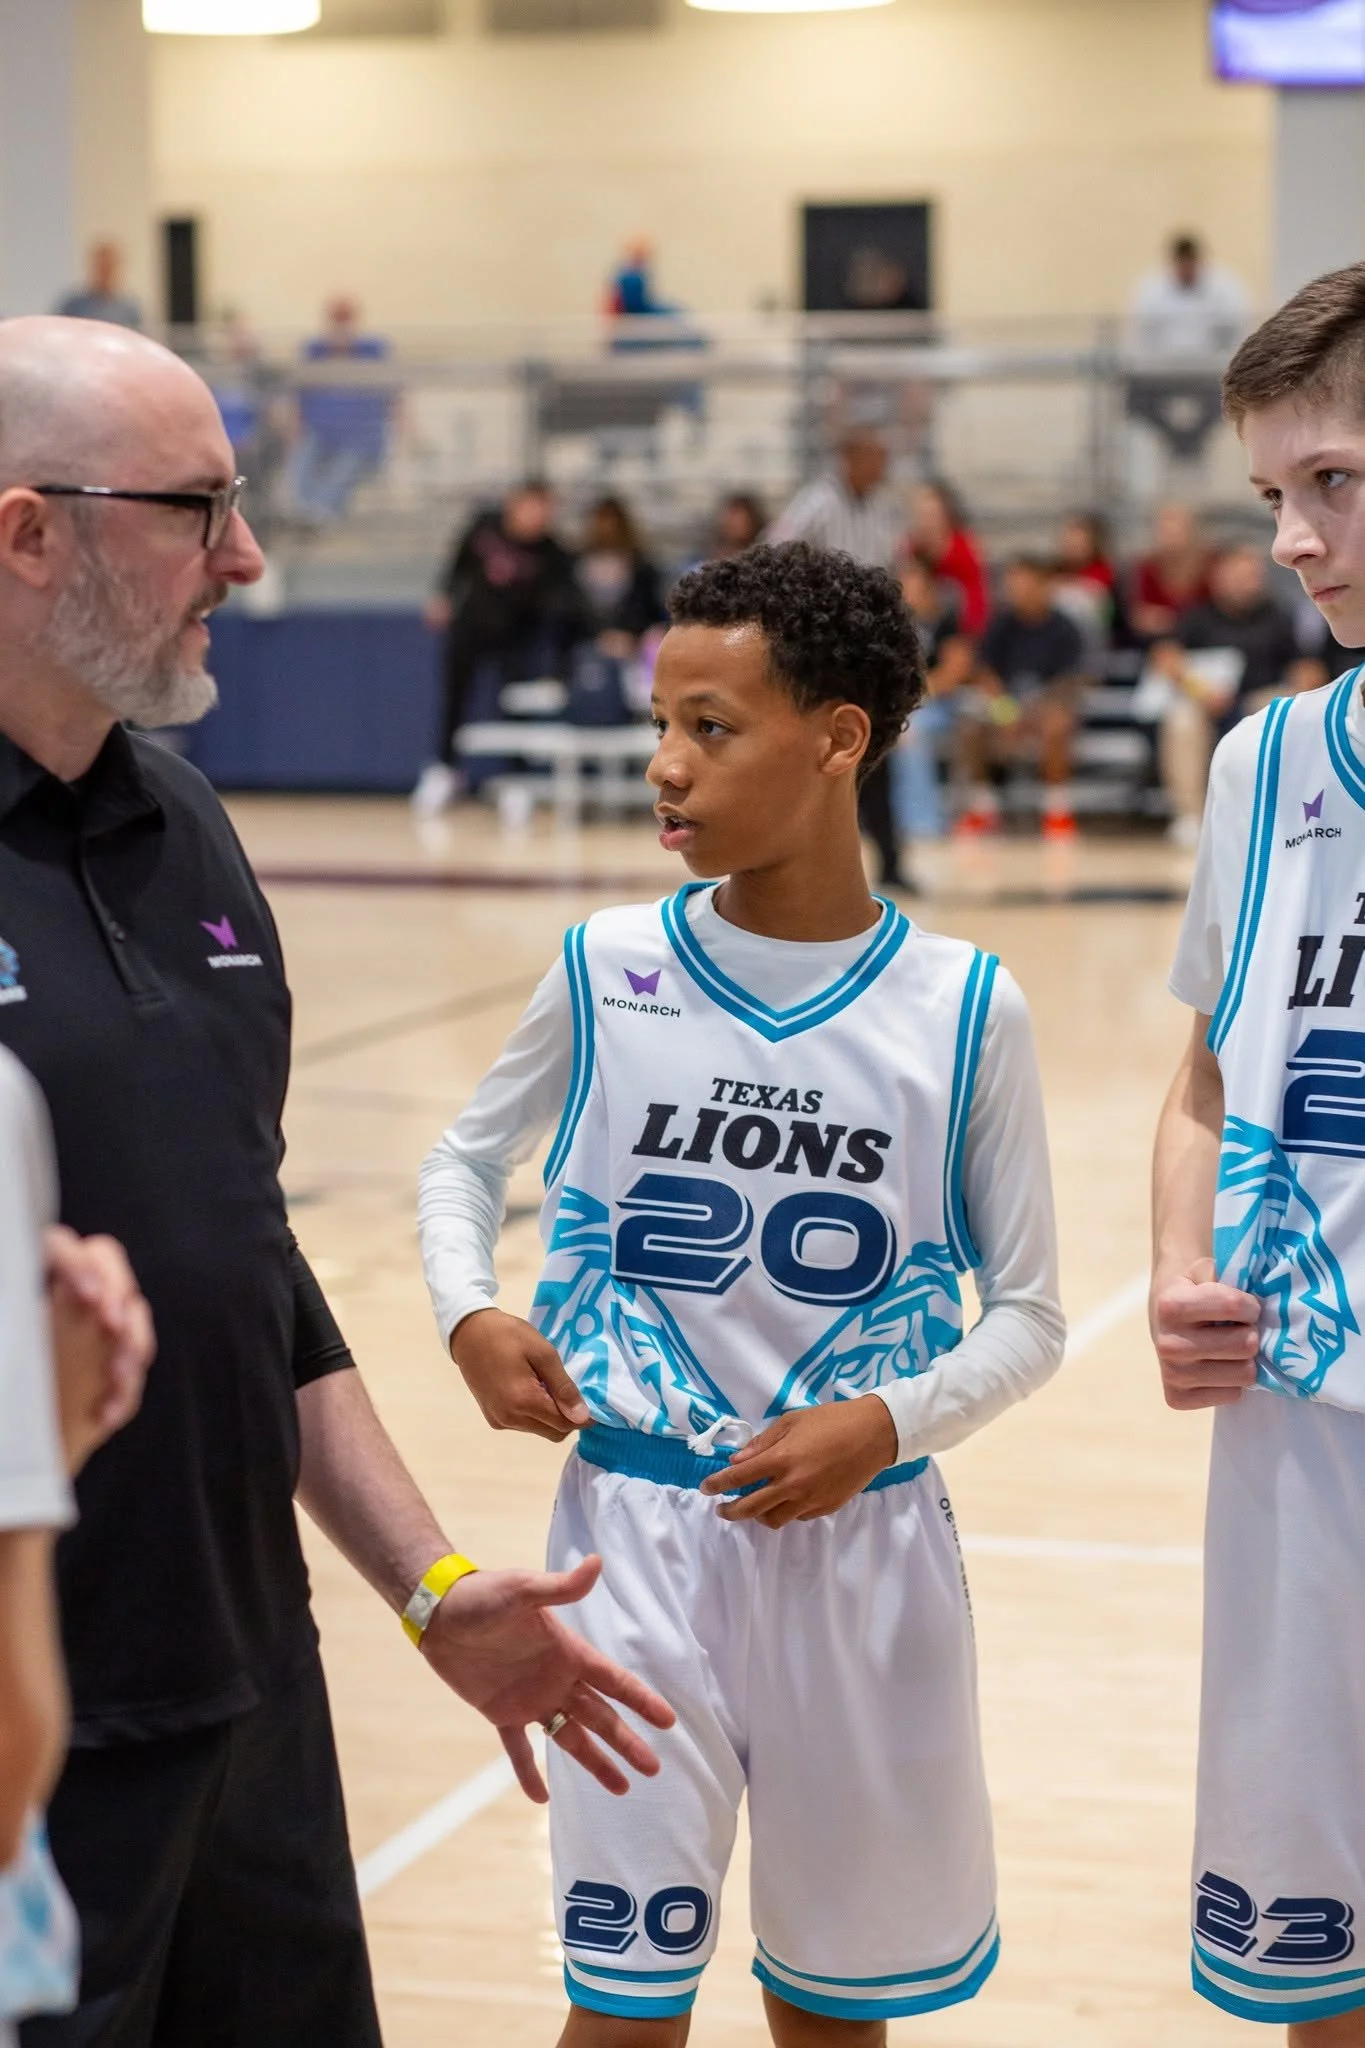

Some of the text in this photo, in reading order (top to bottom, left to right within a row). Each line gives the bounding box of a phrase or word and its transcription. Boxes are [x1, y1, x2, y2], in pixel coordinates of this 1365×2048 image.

[602, 996, 681, 1018] MONARCH
[710, 1077, 823, 1114] TEXAS
[631, 1103, 892, 1184] LIONS
[611, 1171, 898, 1308] 20
[563, 1879, 713, 1956] 20
[1194, 1870, 1355, 1965] 23
